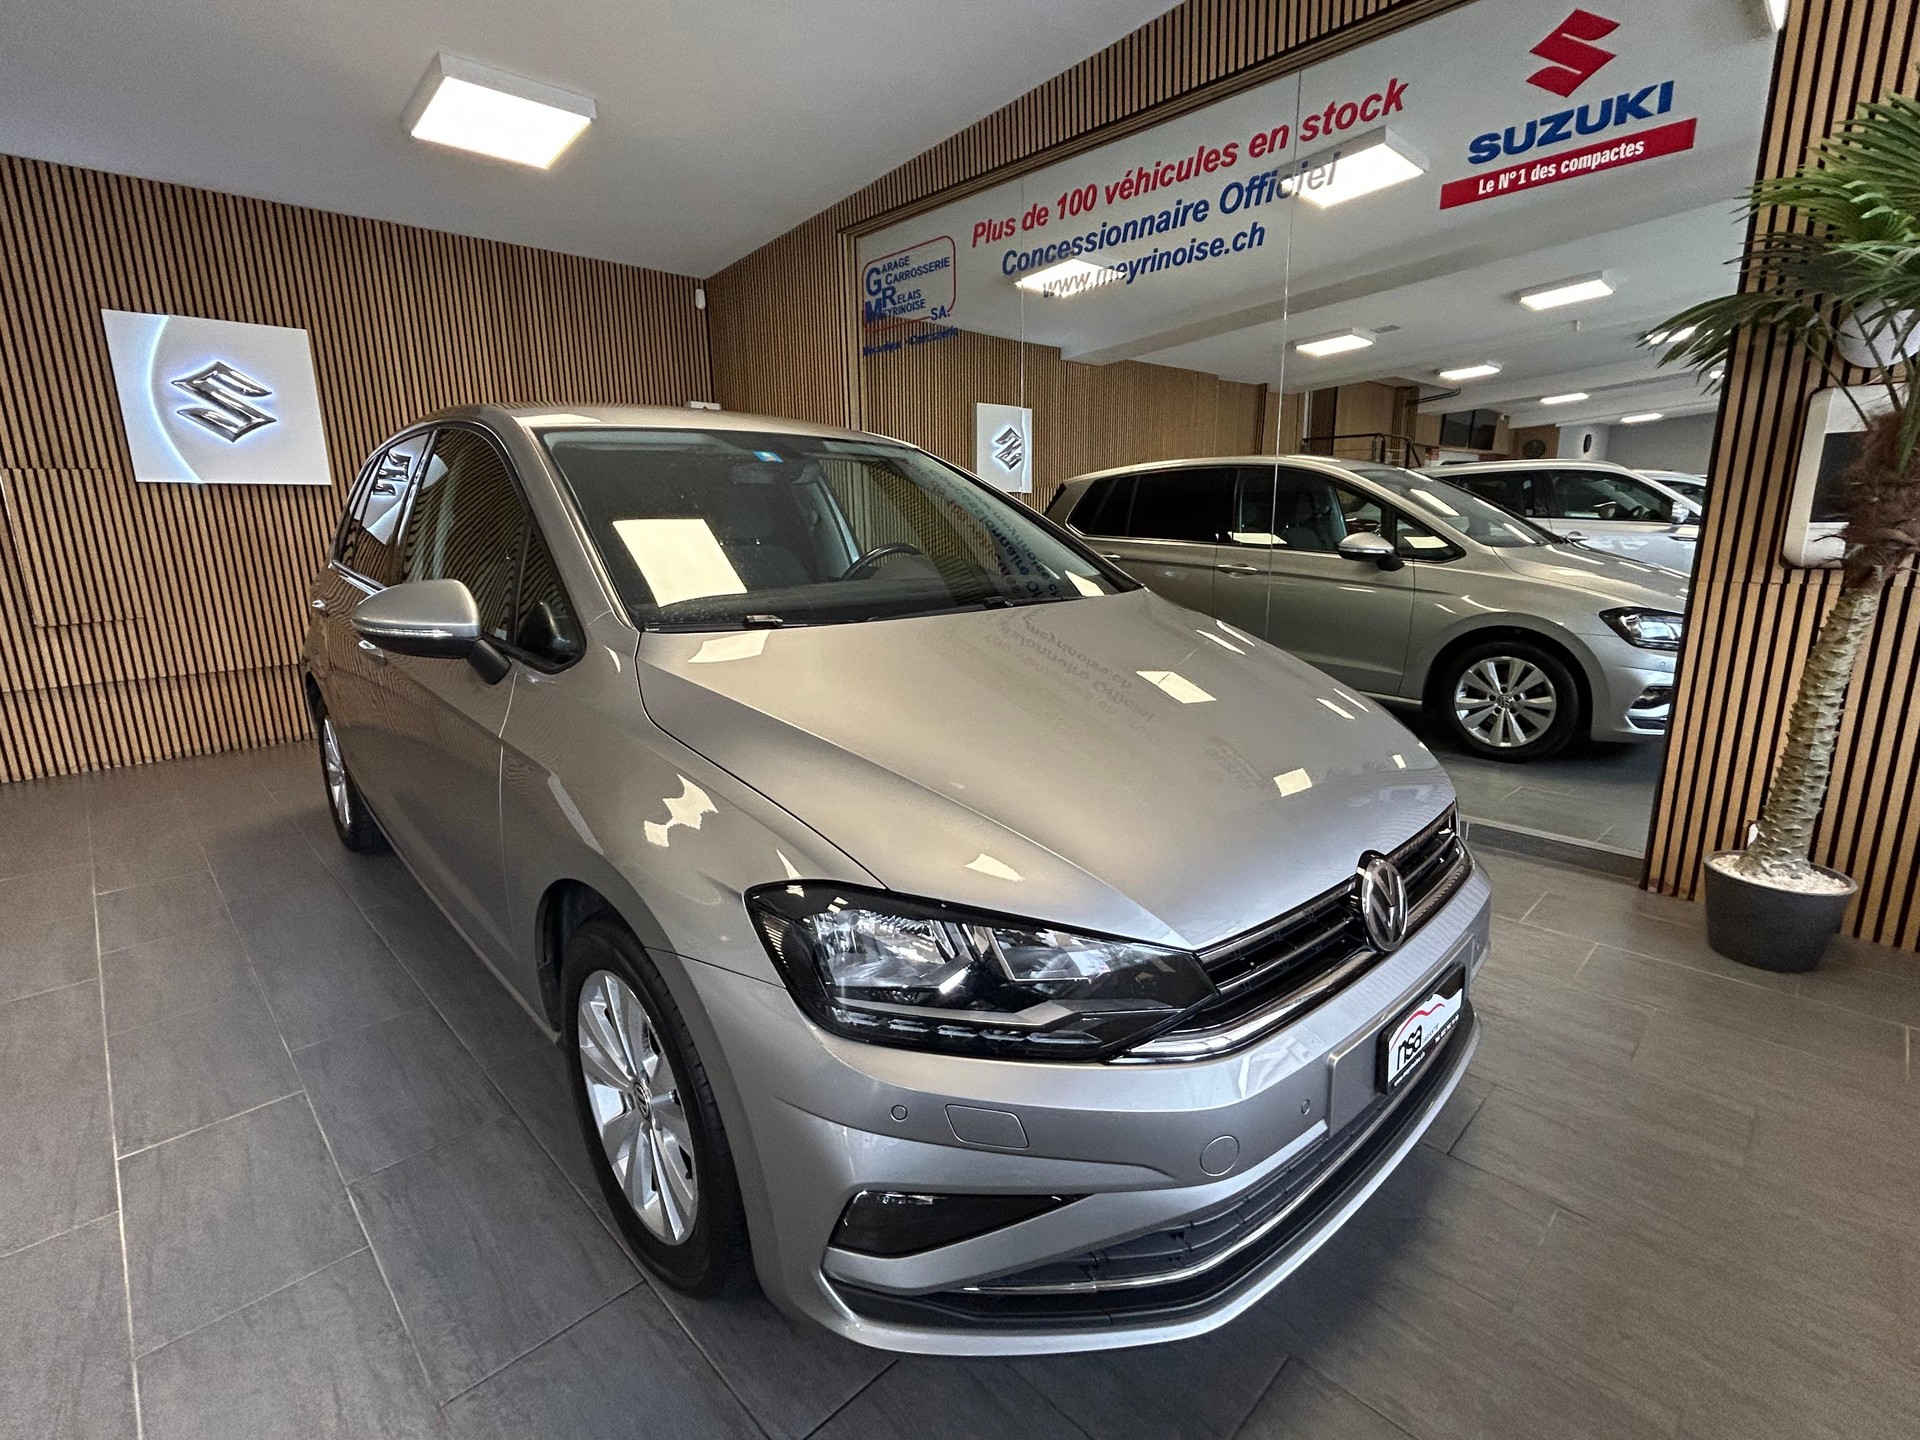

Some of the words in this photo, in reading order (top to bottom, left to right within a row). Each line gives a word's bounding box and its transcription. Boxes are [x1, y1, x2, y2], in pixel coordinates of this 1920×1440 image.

[1467, 80, 1675, 165] SUZUKI
[972, 218, 1016, 248] Plus
[1022, 204, 1049, 232] de
[1057, 184, 1098, 221] 100
[1104, 142, 1239, 205] véhicules
[1248, 124, 1290, 159] en
[1299, 77, 1408, 142] stock
[1478, 178, 1495, 195] Le
[1530, 162, 1557, 182] des
[1560, 139, 1646, 175] compactes
[1001, 198, 1211, 276] Concessionnaire
[1219, 151, 1341, 215] Officiel
[885, 256, 951, 286] CARROSSERIE
[1043, 221, 1267, 299] www.meyrinoise.ch
[1396, 1025, 1422, 1071] nsa
